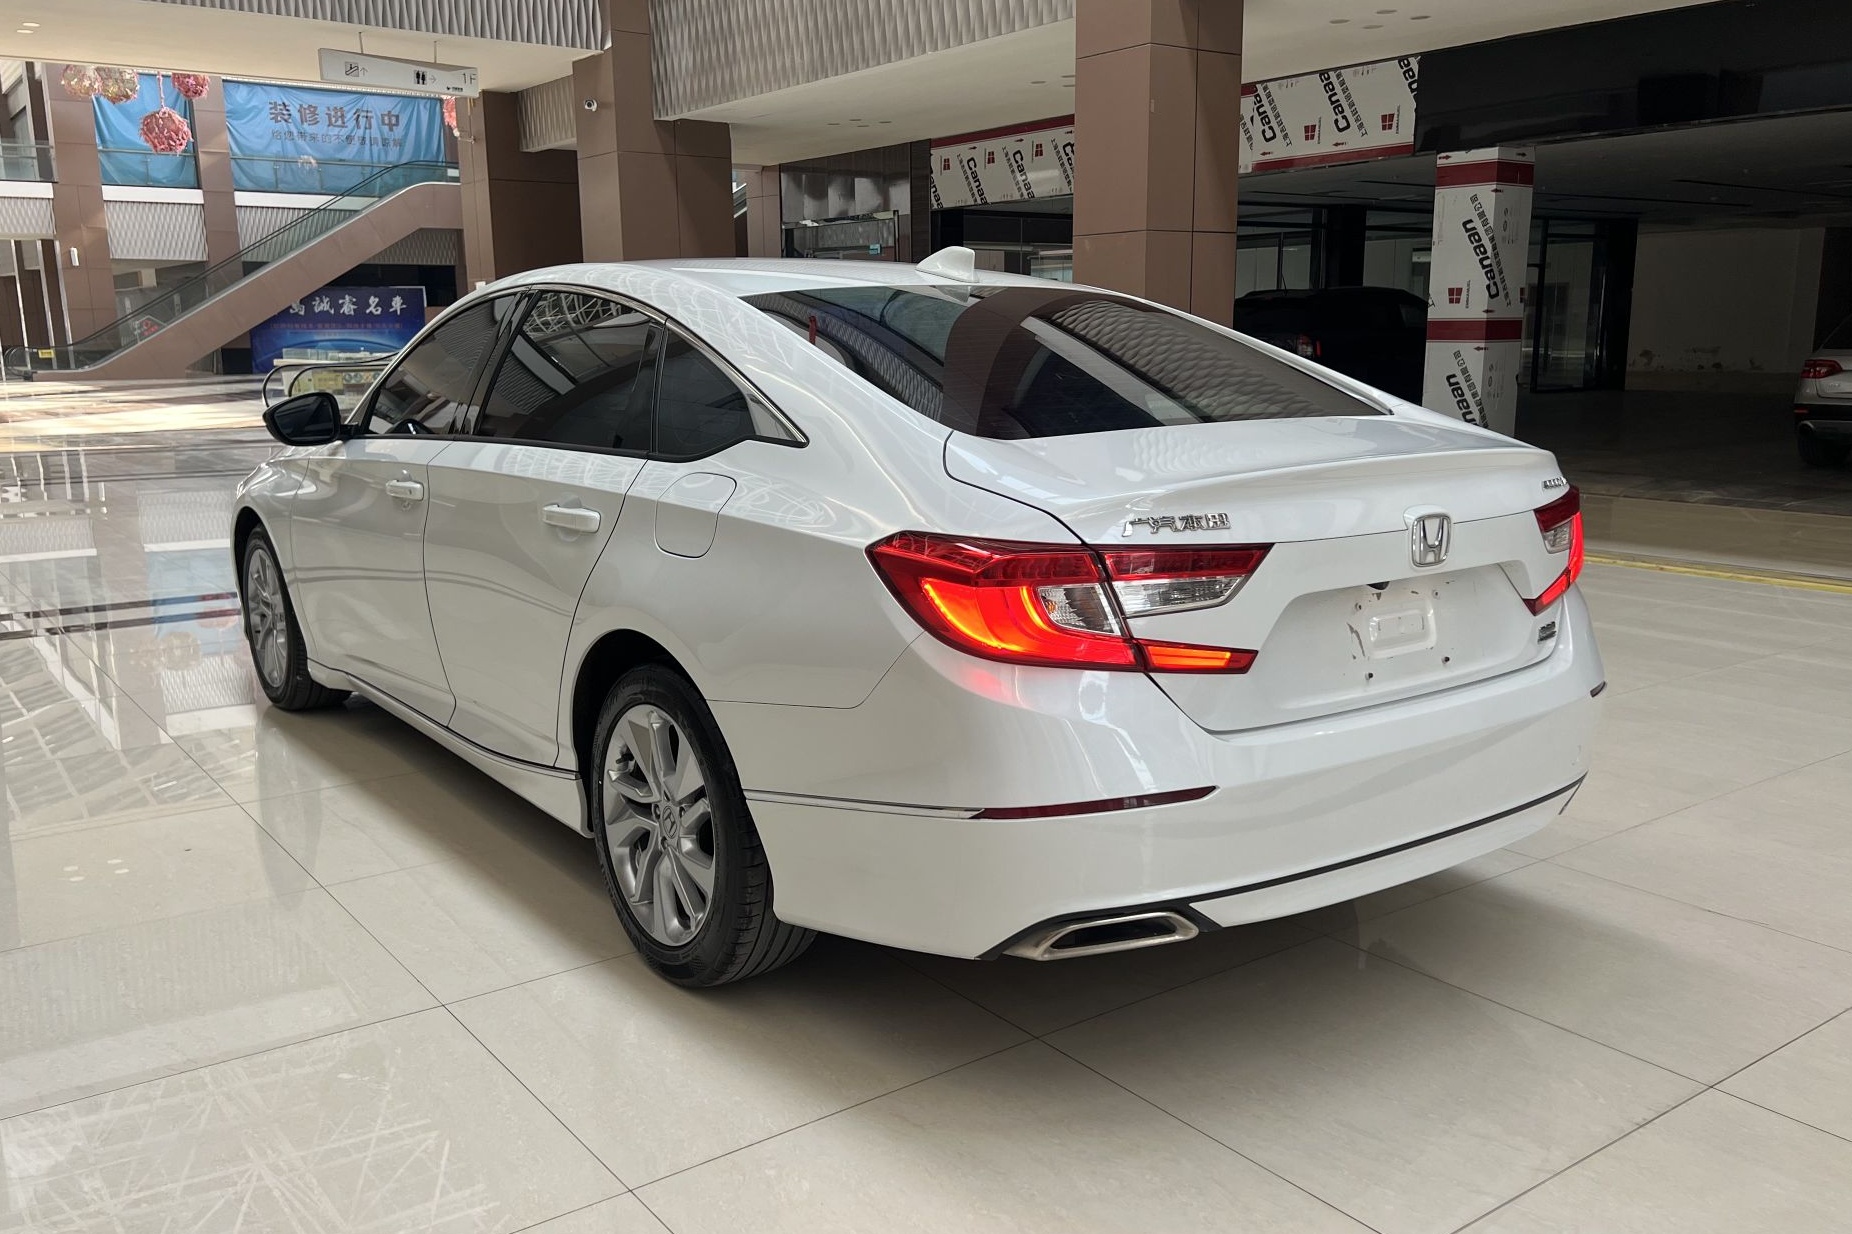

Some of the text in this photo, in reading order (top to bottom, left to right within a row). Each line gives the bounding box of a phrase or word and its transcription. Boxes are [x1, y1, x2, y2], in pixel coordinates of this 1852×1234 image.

[462, 73, 478, 84] 1F
[268, 101, 400, 132] 装修进行中
[1461, 218, 1500, 300] Canaan
[1121, 512, 1232, 538] 广汽本田
